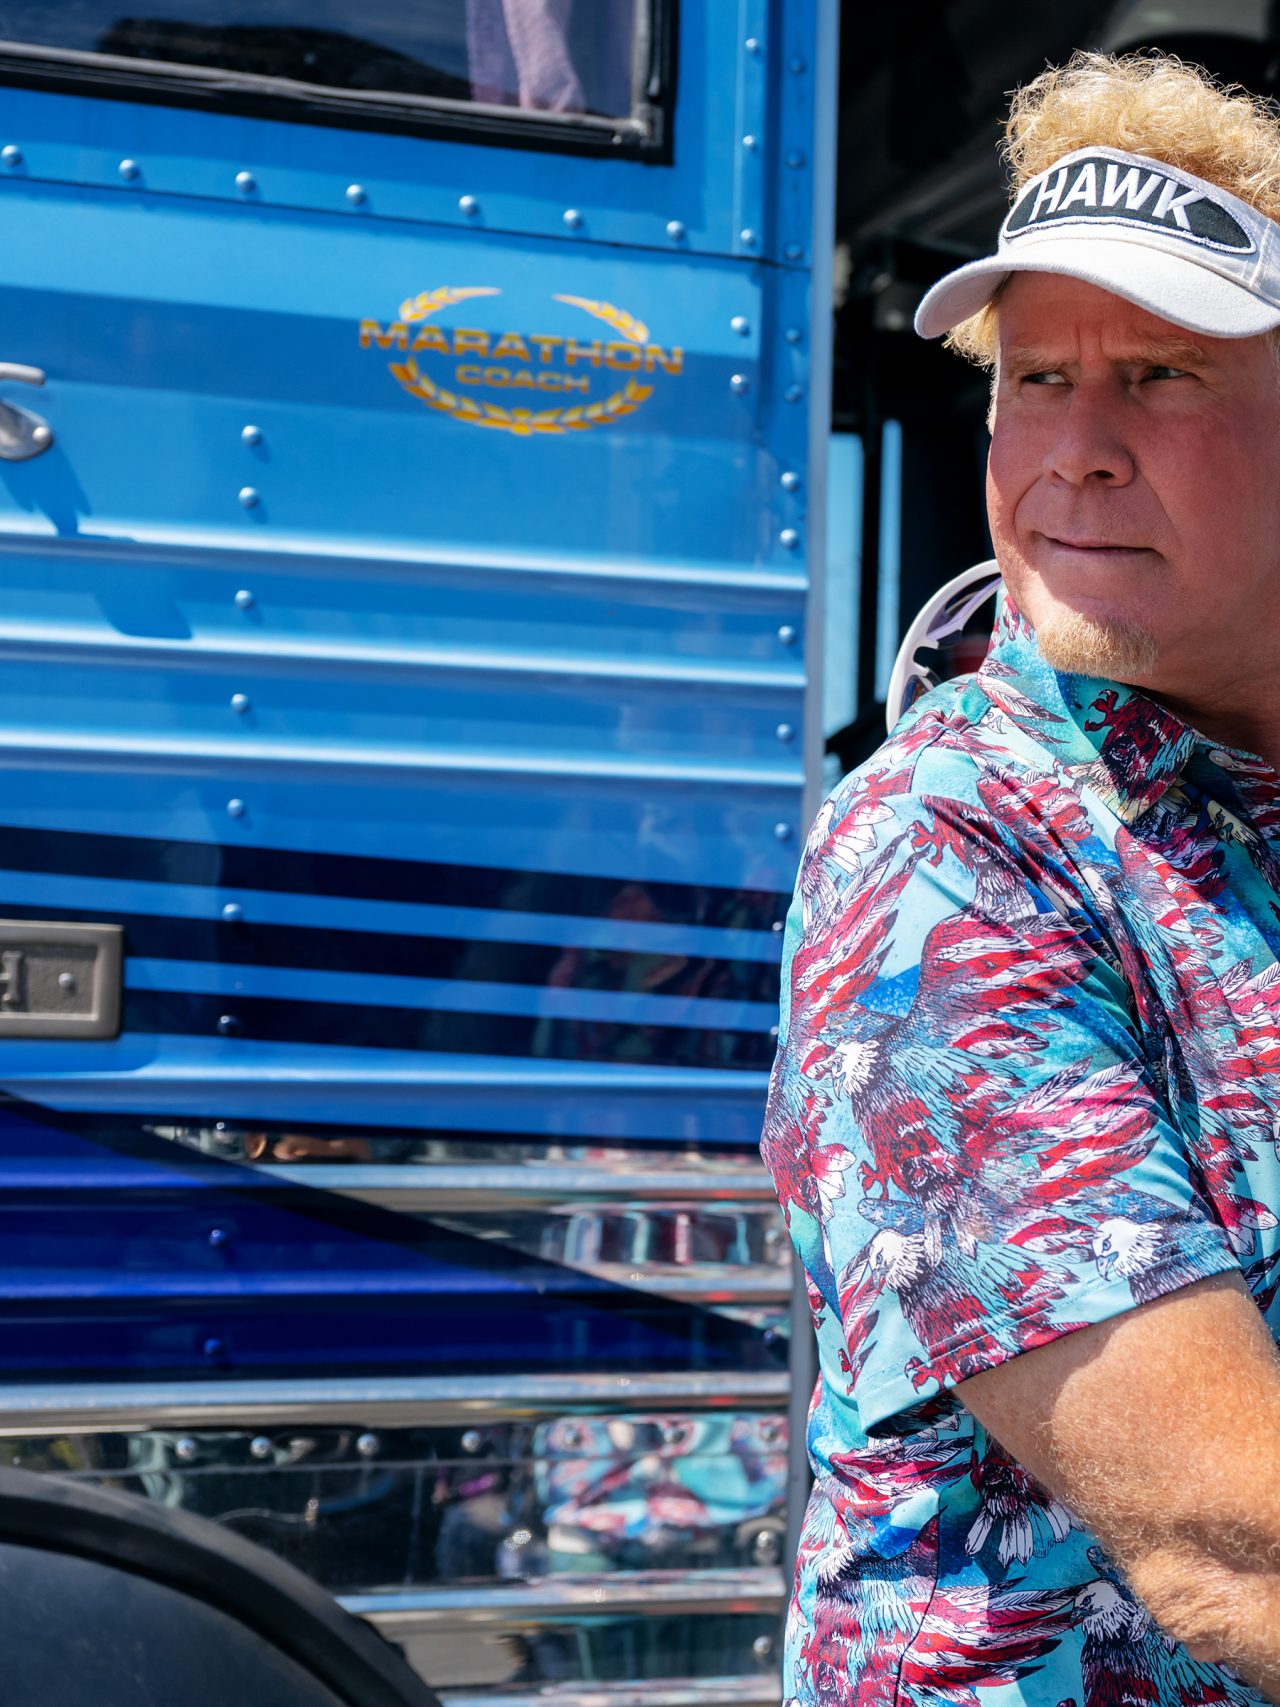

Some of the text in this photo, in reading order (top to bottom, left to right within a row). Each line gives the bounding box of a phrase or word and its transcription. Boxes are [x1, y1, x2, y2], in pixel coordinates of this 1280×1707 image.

[1028, 163, 1207, 231] HAWK
[359, 319, 684, 375] MARATHON
[455, 365, 590, 394] COACH
